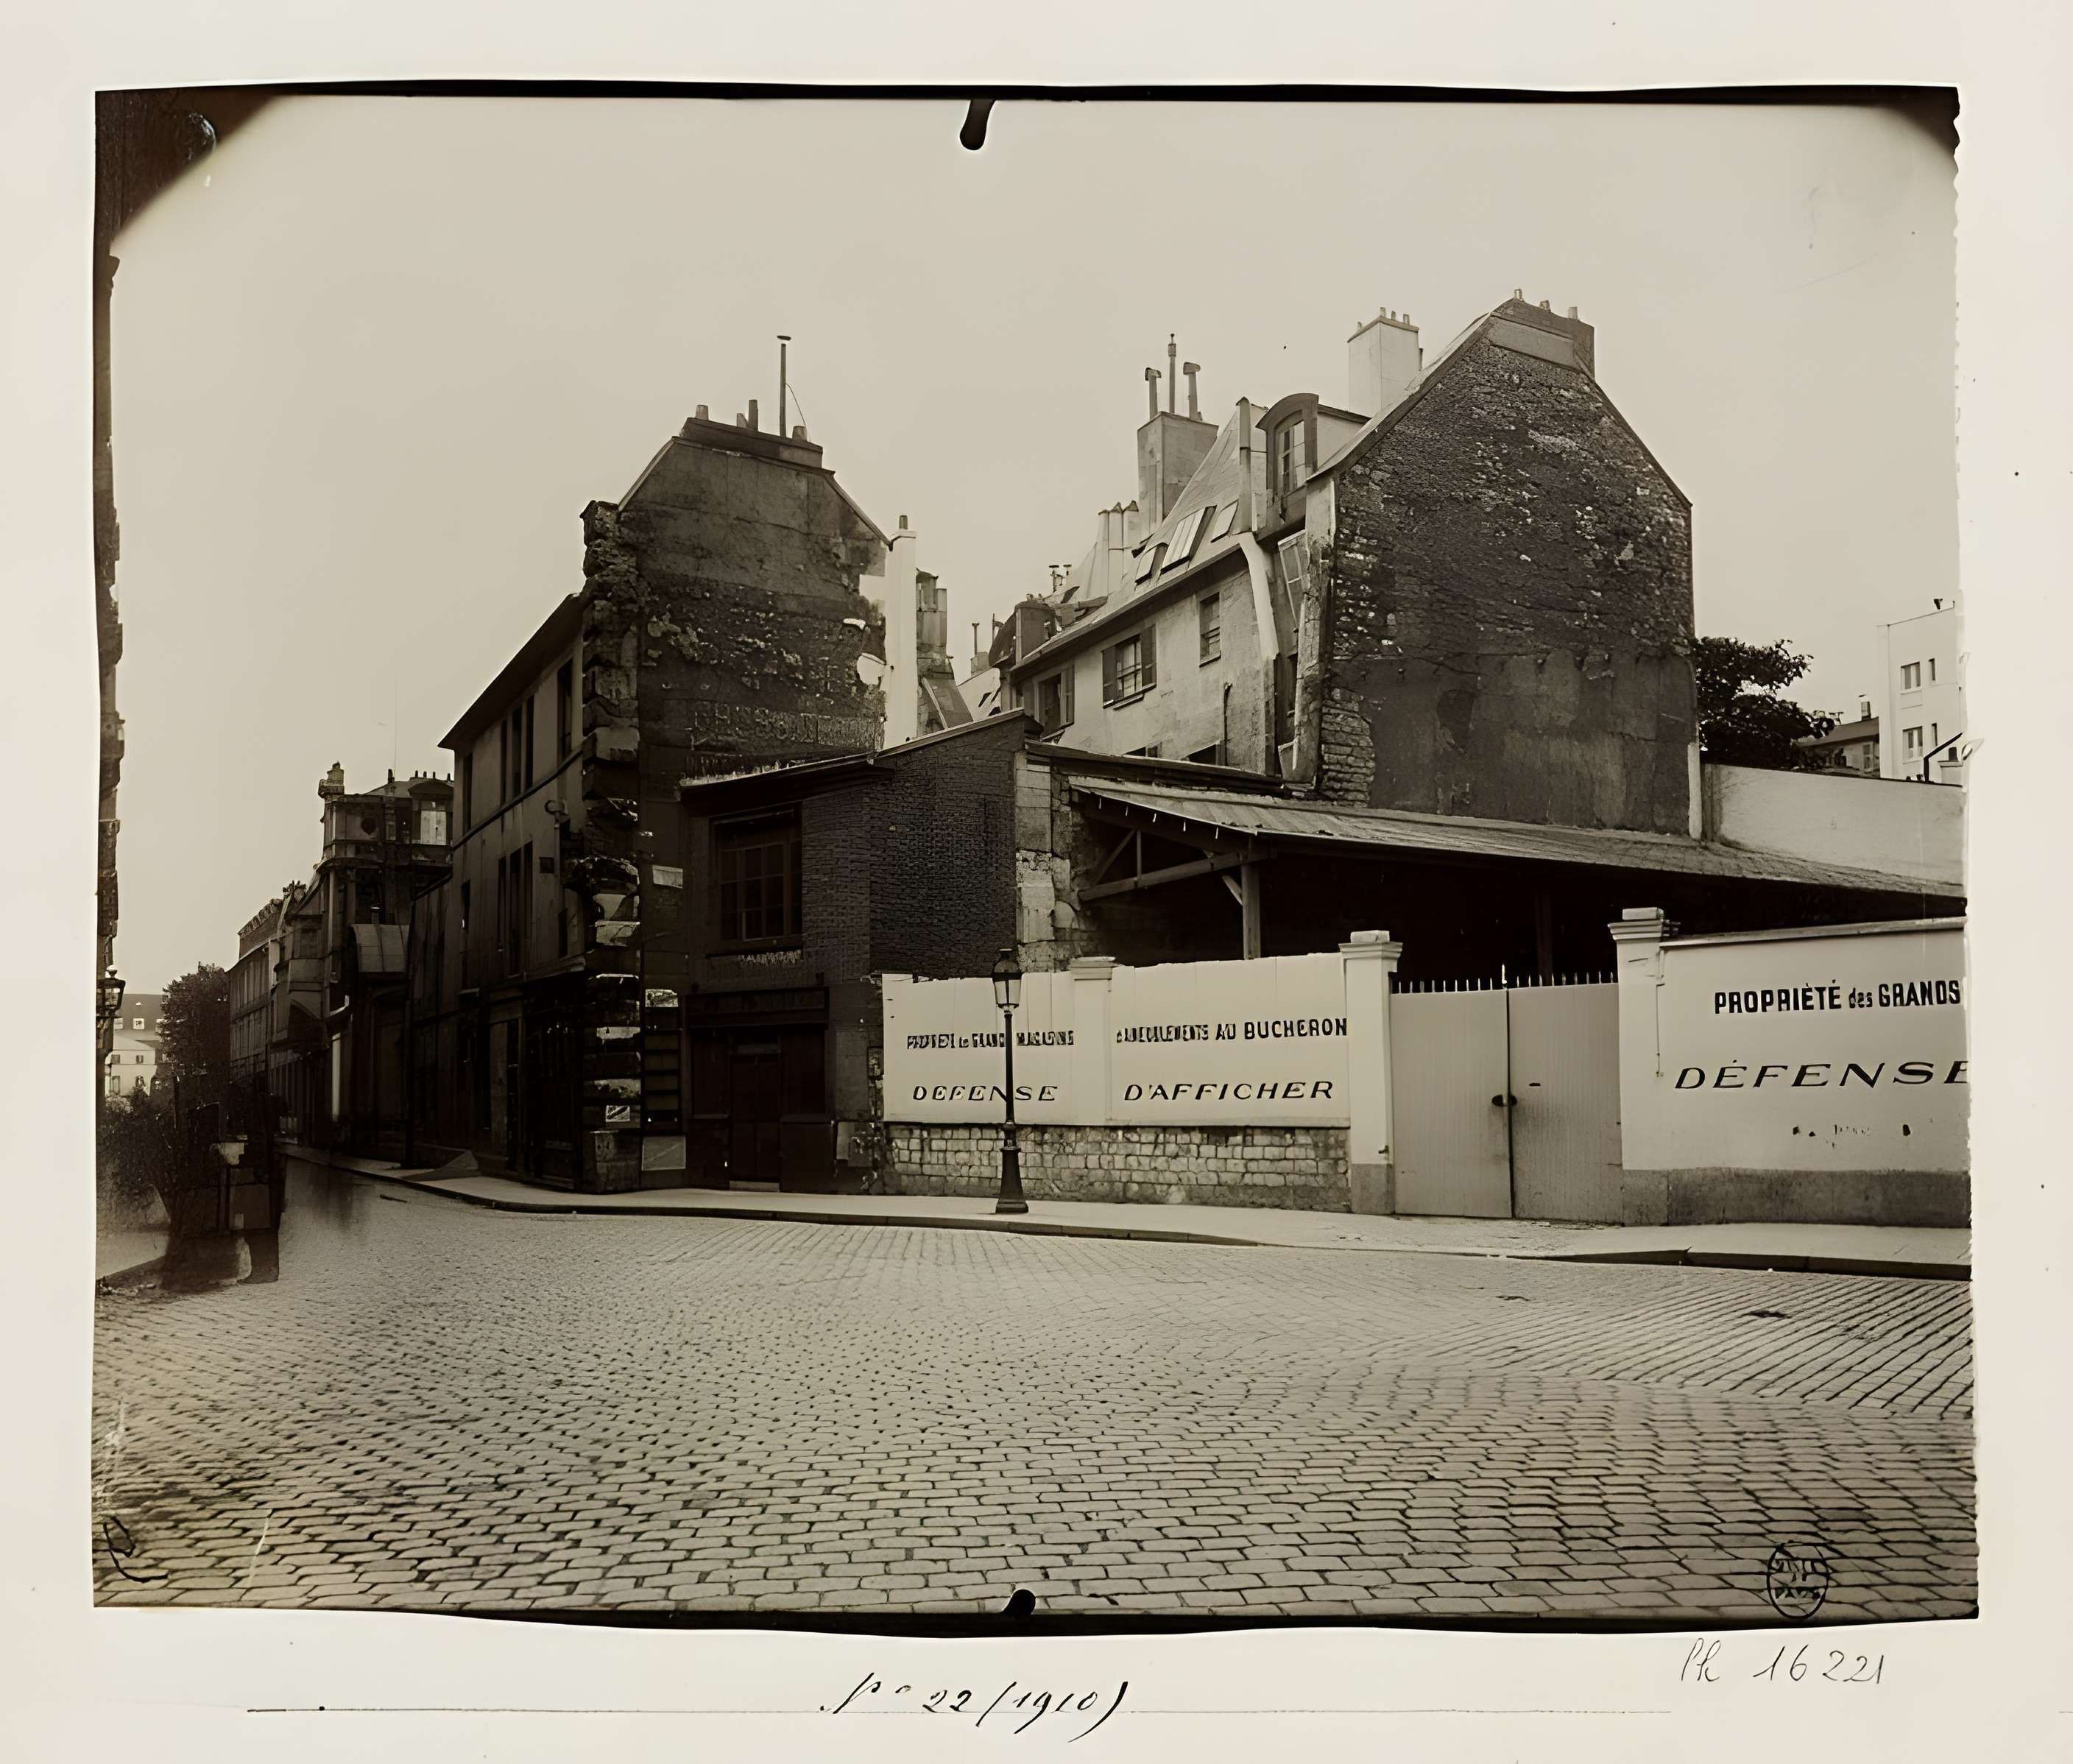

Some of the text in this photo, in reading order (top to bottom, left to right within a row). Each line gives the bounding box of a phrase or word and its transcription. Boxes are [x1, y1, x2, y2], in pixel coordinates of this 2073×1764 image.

[1878, 980, 1961, 1008] GRANDS
[1244, 1018, 1347, 1040] BUCHERON
[1123, 1081, 1333, 1101] D'AFFICHER
